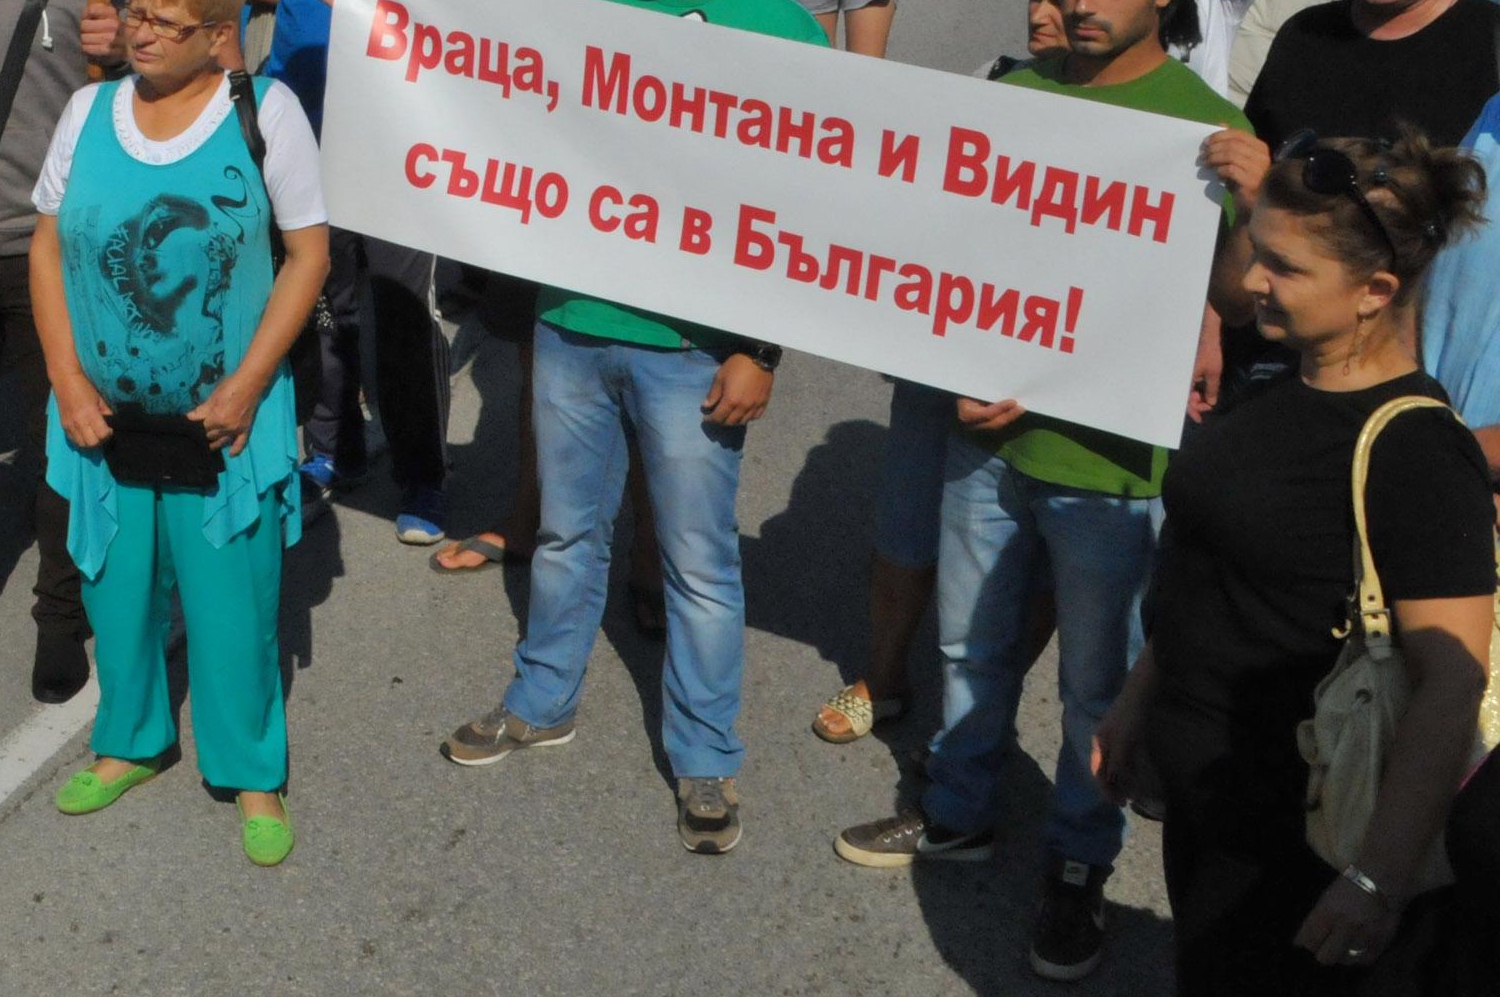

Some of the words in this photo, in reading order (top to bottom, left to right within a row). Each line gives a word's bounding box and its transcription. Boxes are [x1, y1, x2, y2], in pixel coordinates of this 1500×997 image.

[581, 45, 855, 168] Монтана
[877, 129, 921, 183] и
[942, 125, 1177, 244] Видин
[403, 142, 570, 225] също
[588, 183, 661, 243] са
[679, 206, 714, 256] в
[732, 204, 1085, 354] България!
